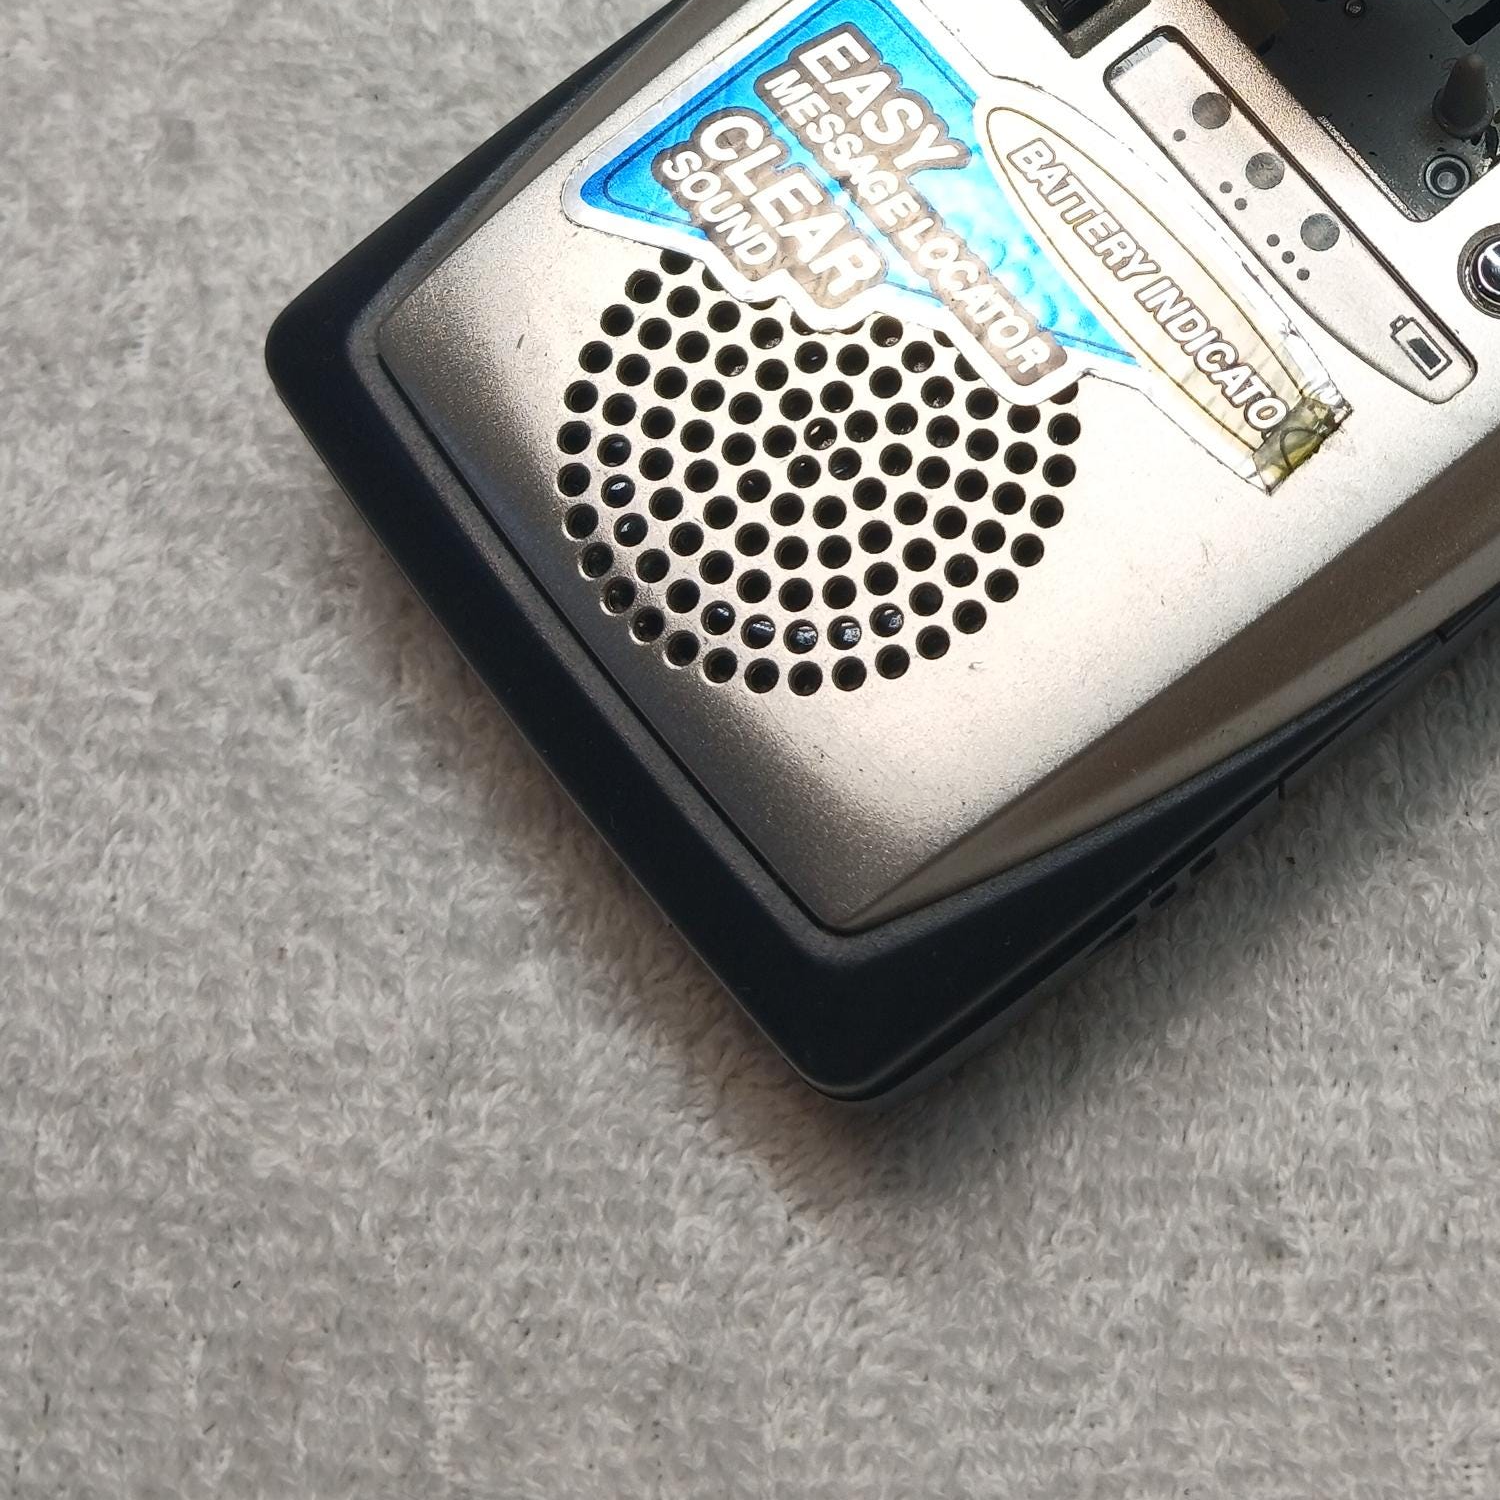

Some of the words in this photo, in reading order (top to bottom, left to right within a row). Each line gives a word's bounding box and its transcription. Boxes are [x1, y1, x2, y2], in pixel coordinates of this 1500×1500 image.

[798, 30, 965, 171] EASY
[662, 150, 778, 266] SOUND
[699, 114, 881, 298] CLEAR
[763, 68, 921, 227] MESSAGE
[897, 216, 1051, 374] LOCATOR
[1007, 137, 1161, 282] BATTERY
[1134, 275, 1291, 441] INDICATO
